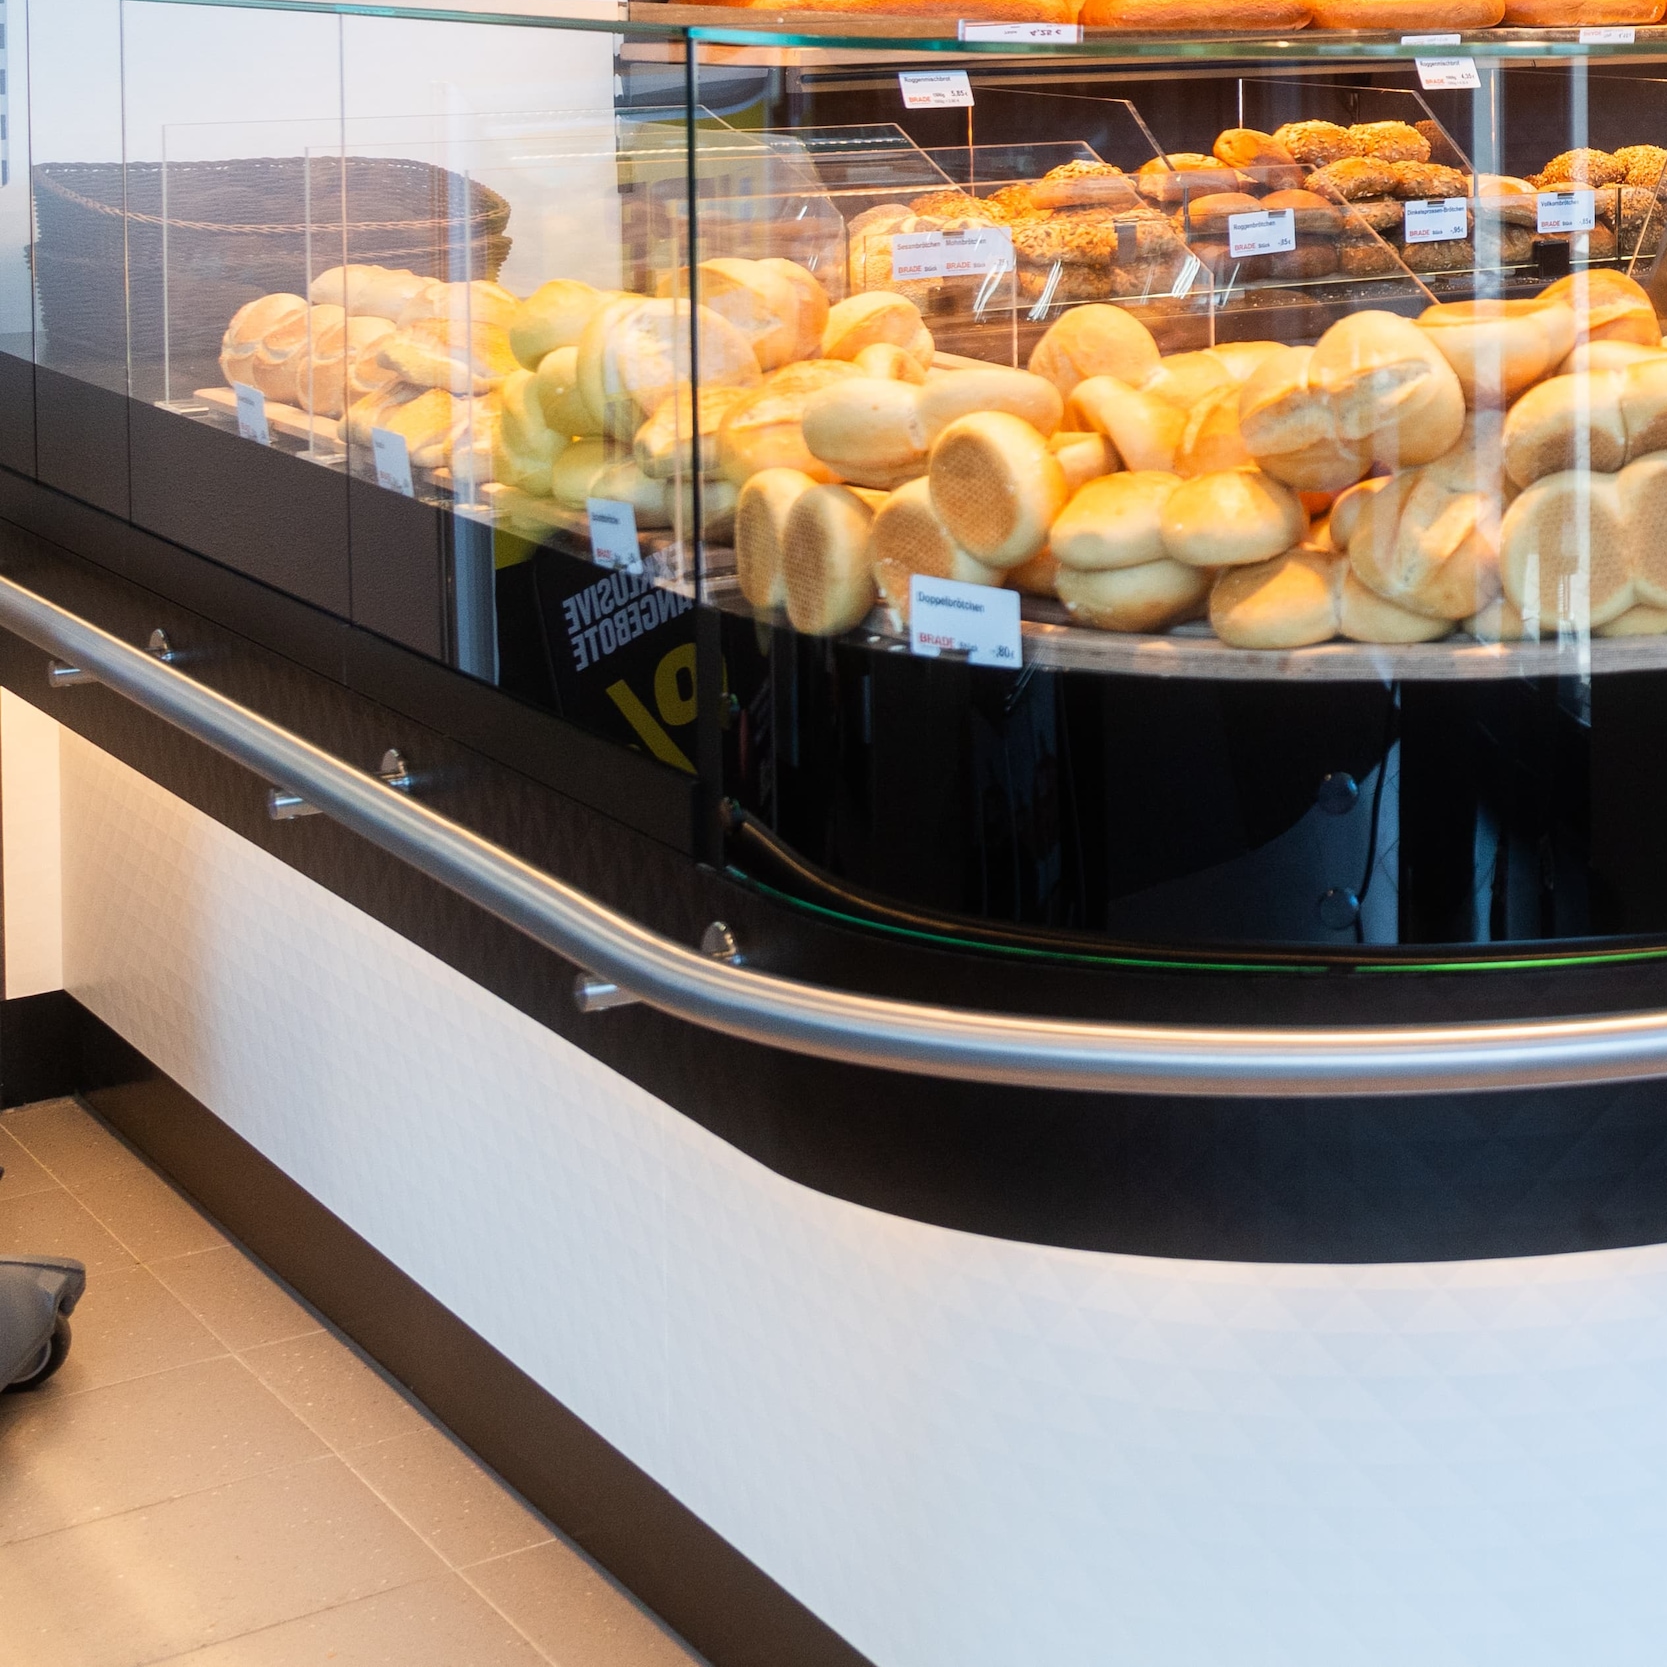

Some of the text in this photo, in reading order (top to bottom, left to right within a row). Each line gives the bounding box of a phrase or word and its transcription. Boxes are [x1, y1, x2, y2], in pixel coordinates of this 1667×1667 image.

[904, 76, 951, 84] Roggenmischbrot
[909, 95, 931, 103] BRADE
[1233, 220, 1276, 231] Roggenbrötchen
[1541, 220, 1561, 228] BRADE
[1409, 228, 1431, 237] BRADE
[897, 238, 987, 250] Sesambrötchen Mohnbrötchen
[1234, 242, 1256, 251] BRADE
[946, 261, 971, 270] BRADE
[918, 591, 985, 613] Doppelbrötchen
[919, 632, 955, 648] BRADE
